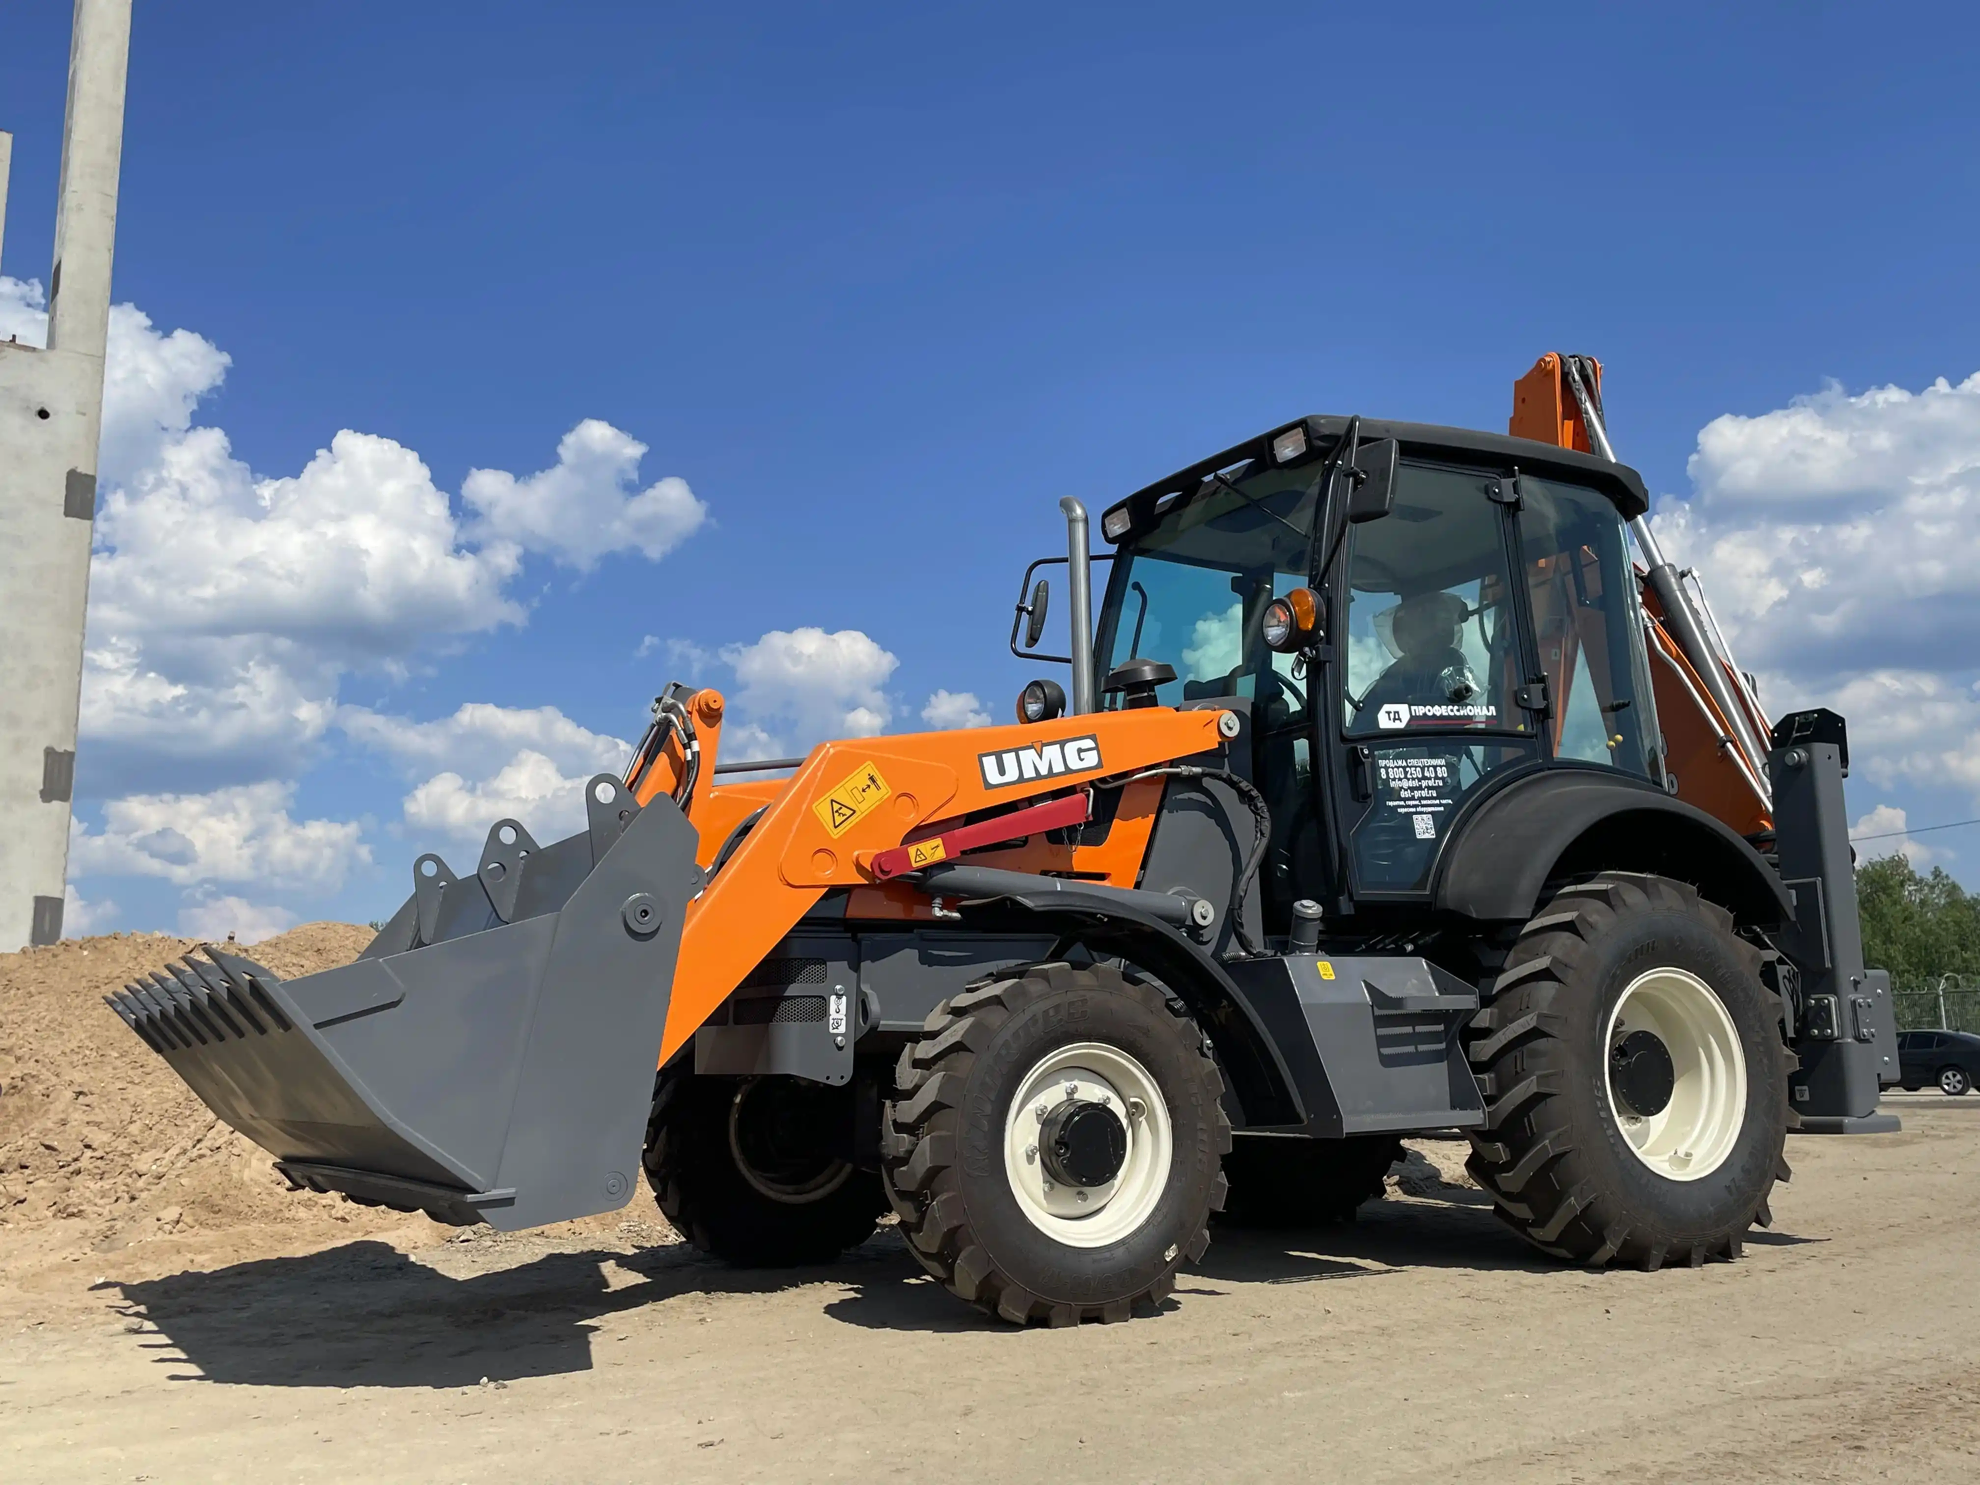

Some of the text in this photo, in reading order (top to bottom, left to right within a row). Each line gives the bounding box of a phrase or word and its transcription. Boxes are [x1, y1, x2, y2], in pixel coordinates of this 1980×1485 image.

[1385, 705, 1496, 723] ТД ПРОФЕССИОНАЛ
[981, 738, 1099, 785] UMG
[1378, 758, 1446, 768] ПРОДАЖА СПЕЦТЕХНИКИ
[1380, 766, 1448, 779] 8 800 250 40 80
[1389, 778, 1443, 789] info@dst-prof.ru
[1400, 788, 1437, 799] dst-prof.ru
